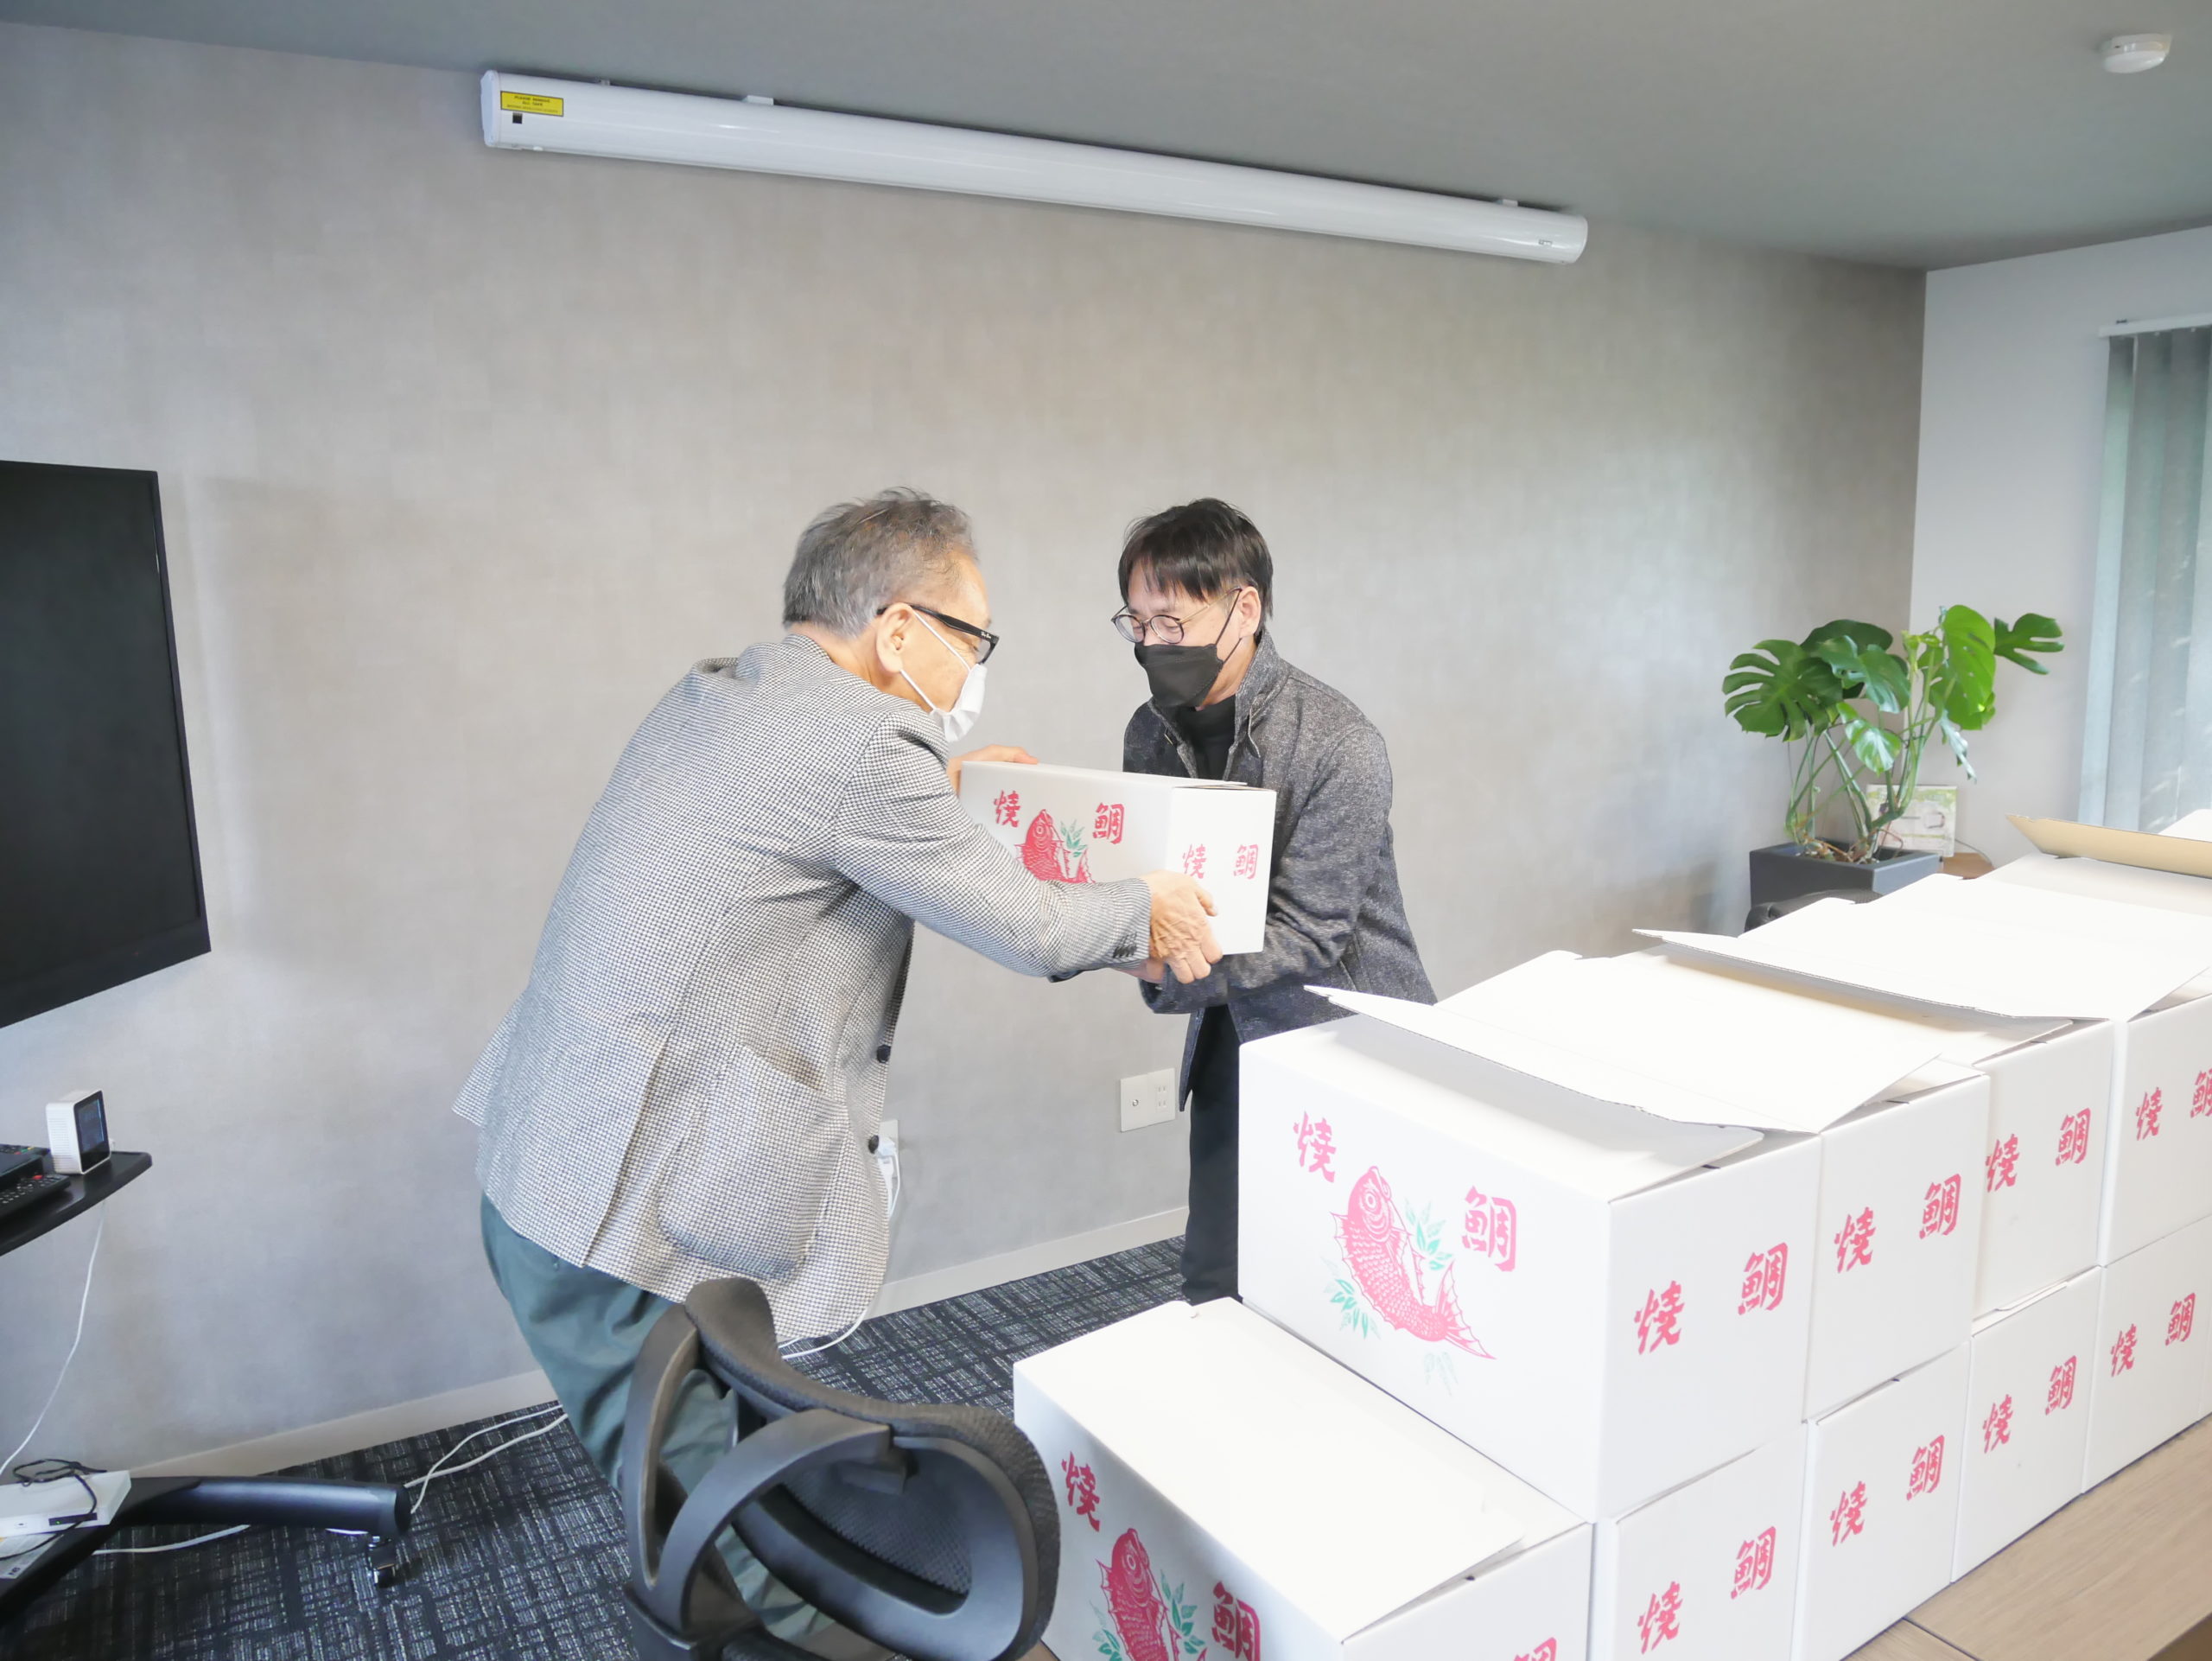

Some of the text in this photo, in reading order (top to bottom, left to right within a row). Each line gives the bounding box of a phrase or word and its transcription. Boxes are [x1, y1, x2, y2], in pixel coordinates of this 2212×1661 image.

[1092, 802, 1125, 845] 鯛
[1234, 844, 1259, 880] 鯛
[2056, 1107, 2092, 1167] 鯛
[1461, 1186, 1517, 1273] 鯛
[1919, 1173, 1962, 1240] 鯛
[1737, 1241, 1789, 1315] 鯛
[2164, 1292, 2196, 1346] 鯛
[2045, 1354, 2078, 1416] 鯛
[1906, 1435, 1946, 1501] 鯛
[1730, 1525, 1777, 1600] 鯛
[1211, 1581, 1261, 1661] 鯛
